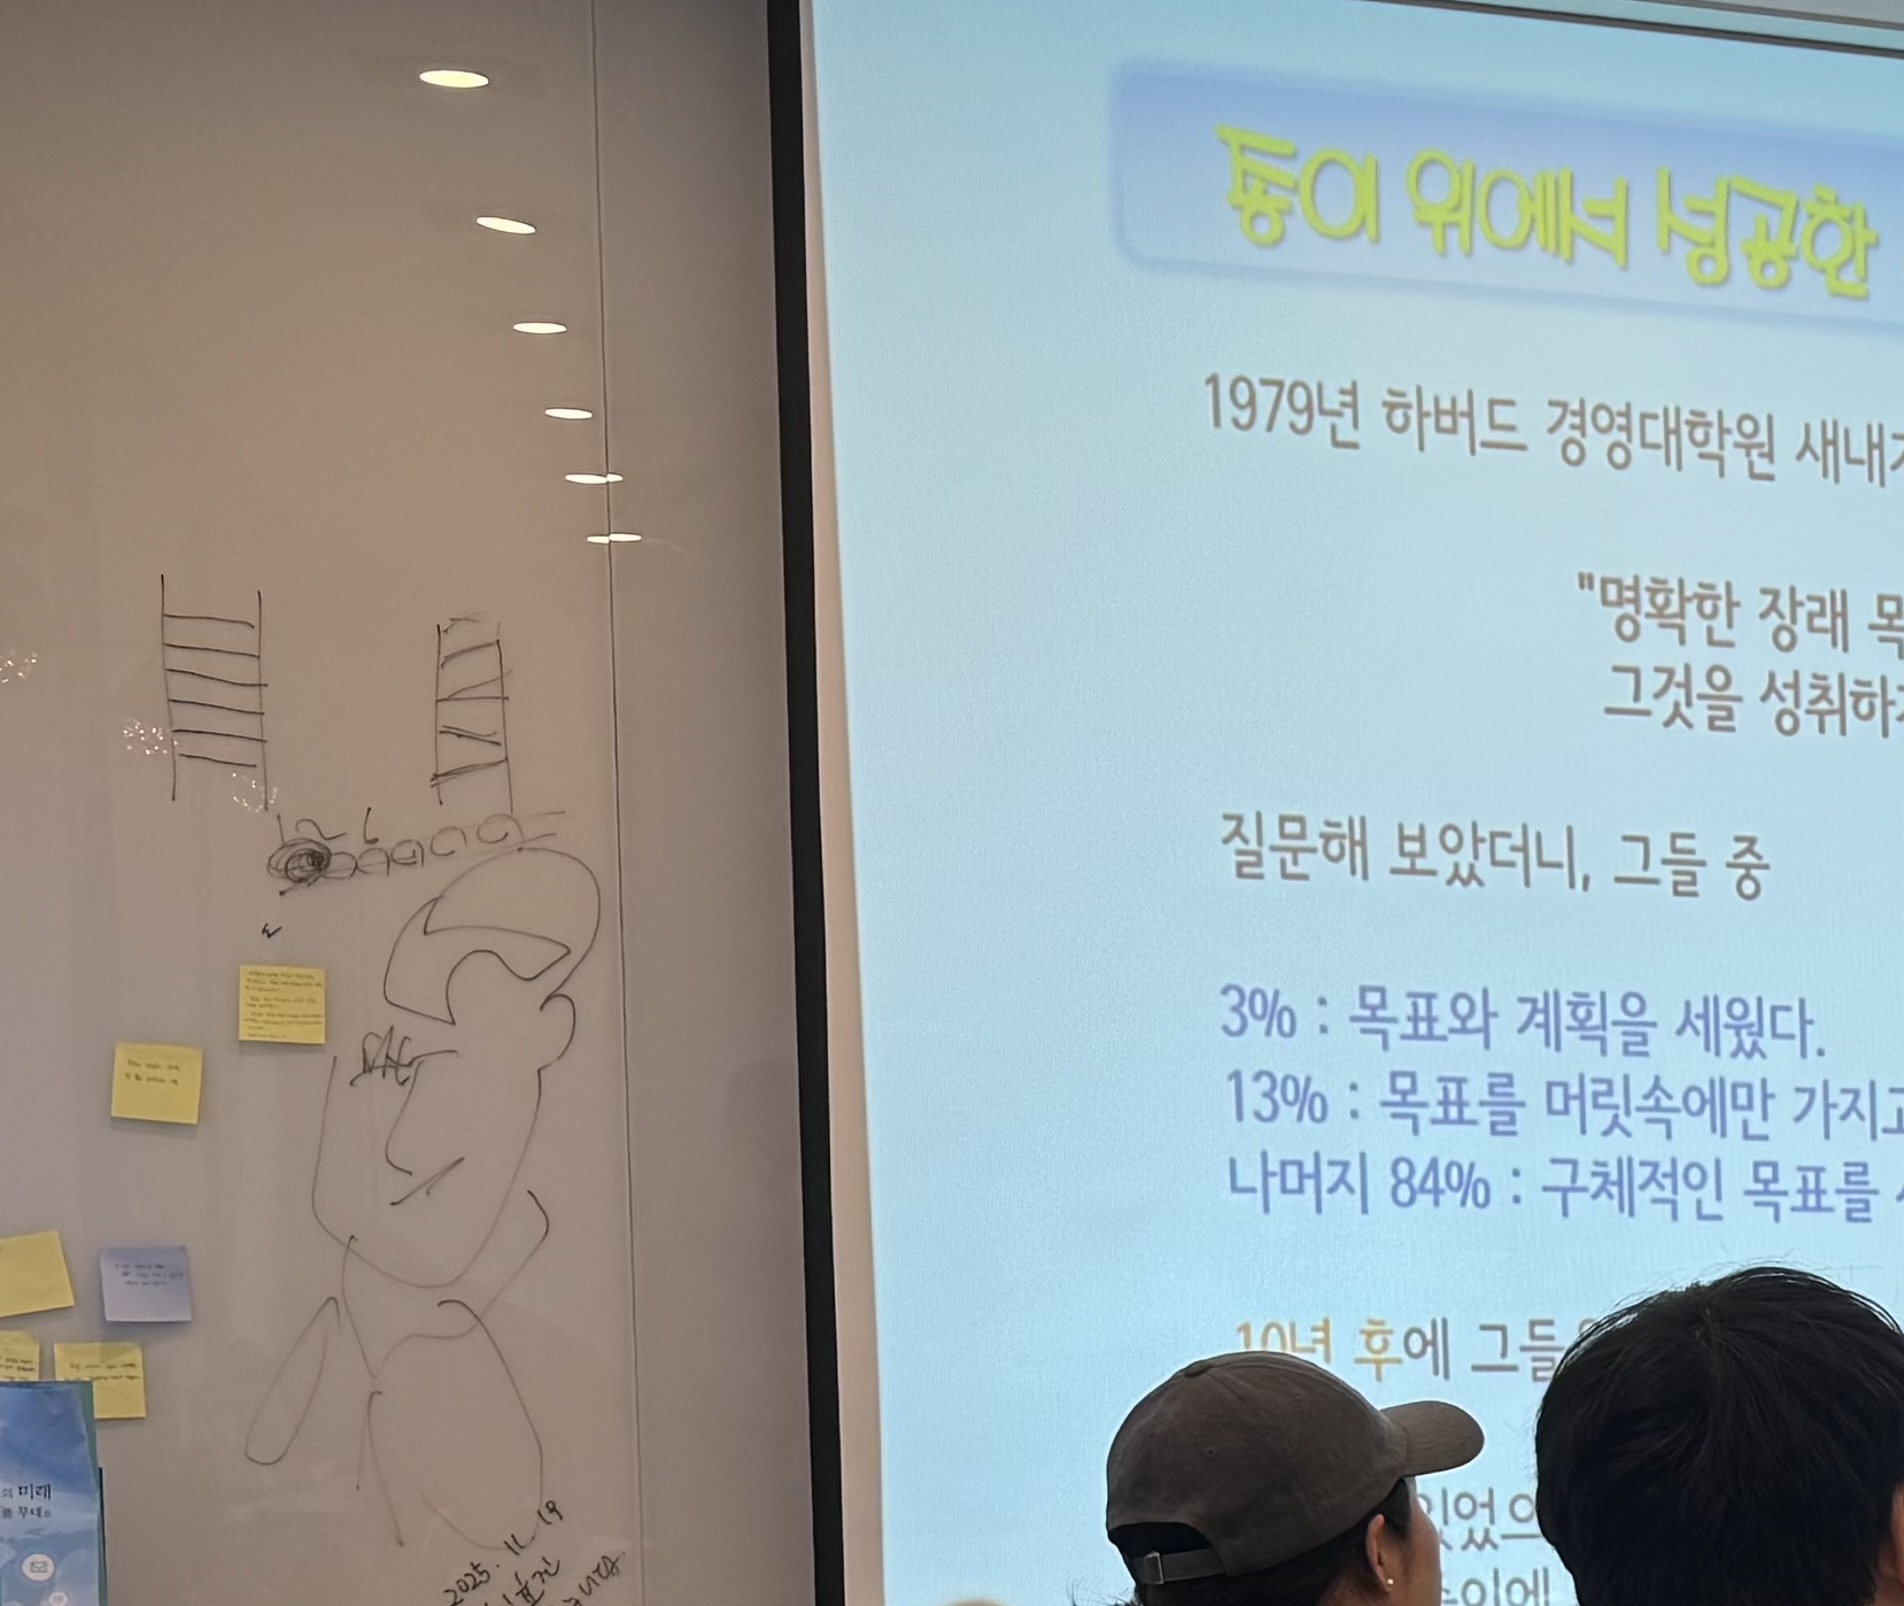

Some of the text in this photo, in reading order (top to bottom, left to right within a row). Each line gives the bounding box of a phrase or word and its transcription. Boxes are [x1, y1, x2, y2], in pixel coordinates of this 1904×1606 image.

[1405, 148, 1629, 270] 위에서
[1656, 166, 1880, 301] 성공한
[1205, 373, 1360, 450] 1979년
[1382, 385, 1528, 456] 하버드
[1547, 398, 1775, 482] 경영대학원
[1578, 572, 1741, 648] "명확한
[1759, 585, 1849, 653] 장래
[1604, 663, 1743, 733] 그것을
[1222, 811, 1770, 901] 질문해 보았더니, 그들 중
[1221, 984, 1297, 1038] 3%
[1349, 985, 1499, 1051] 목표와
[1517, 989, 1658, 1057] 계획을
[1675, 994, 1825, 1060] 세웠다.
[1228, 1069, 1328, 1124] 13%
[1380, 1070, 1526, 1137] 목표를
[1546, 1072, 1776, 1141] 머릿속에만
[1229, 1150, 1369, 1215] 나머지
[1391, 1156, 1491, 1209] 84%
[1541, 1156, 1723, 1222] 구체적인
[1743, 1160, 1880, 1223] 목표를
[1353, 1318, 1450, 1382] 후에
[1471, 1318, 1596, 1382] 그들
